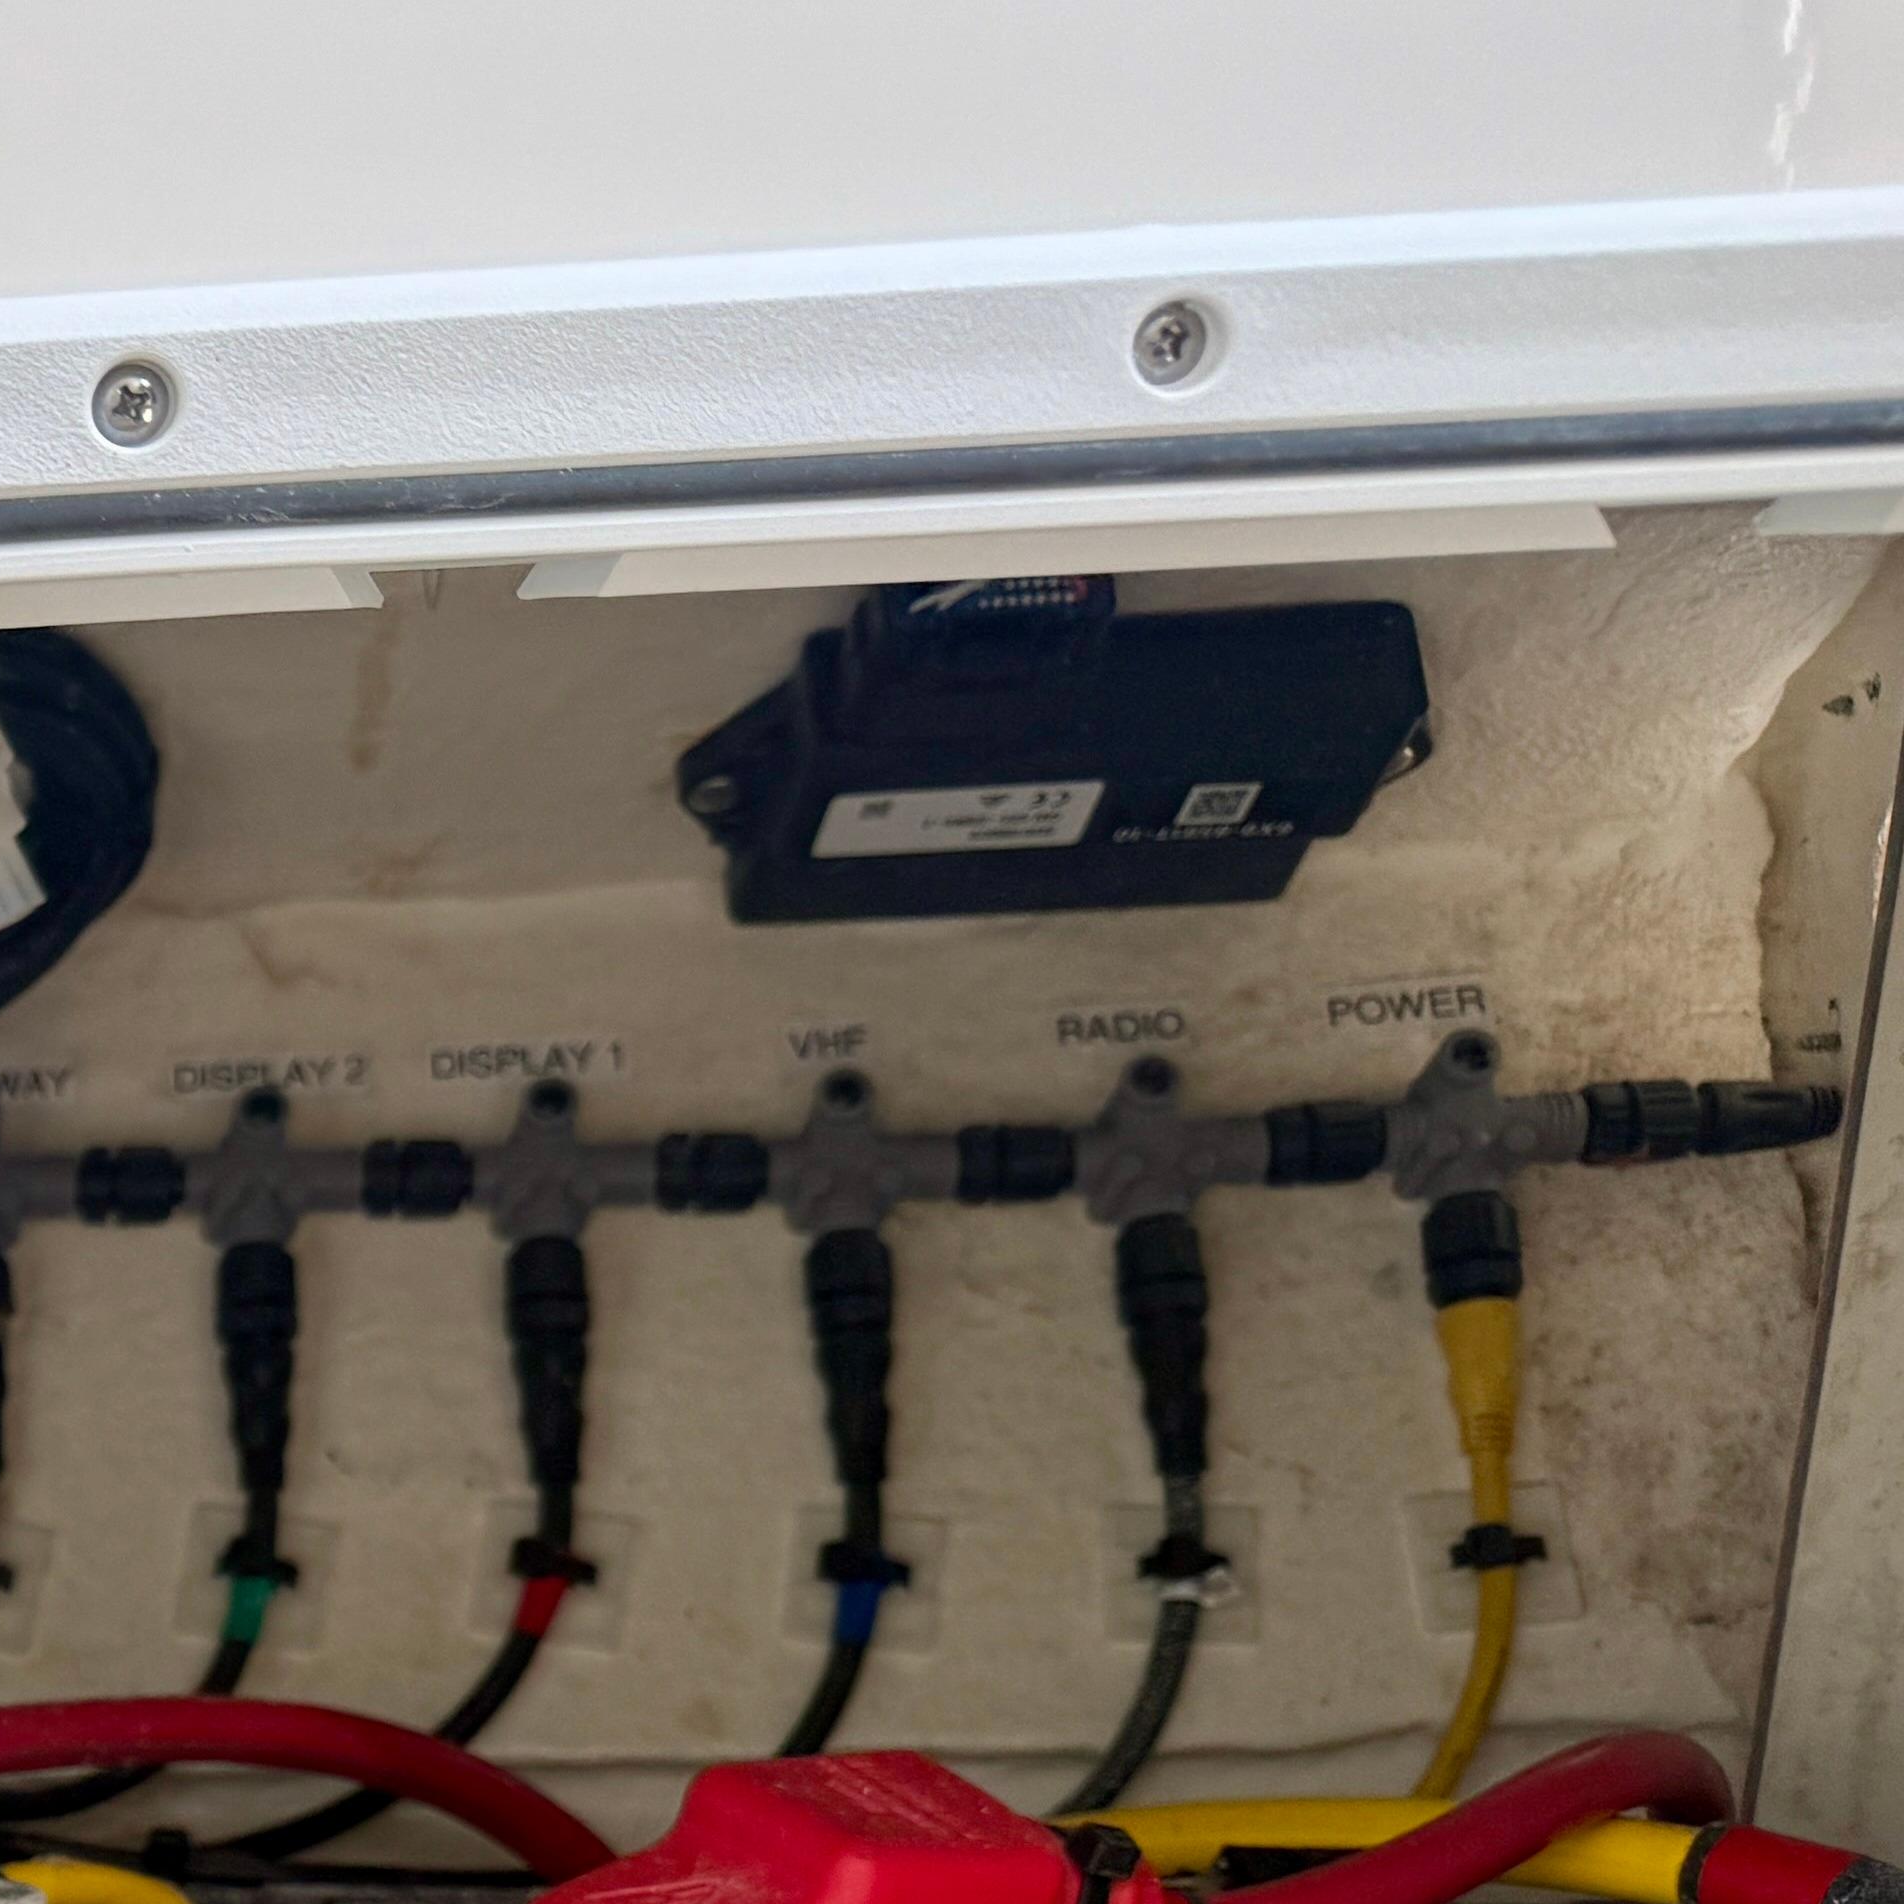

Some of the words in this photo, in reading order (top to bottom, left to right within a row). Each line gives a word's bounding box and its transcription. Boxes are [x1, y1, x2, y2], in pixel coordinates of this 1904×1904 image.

[1056, 1007, 1185, 1045] RADIO
[1326, 983, 1488, 1028] POWER
[430, 1040, 594, 1081] DISPLAY
[606, 1041, 625, 1072] 1
[788, 1023, 868, 1059] VHF
[172, 1055, 337, 1095] DISPLAY
[343, 1052, 370, 1087] 2
